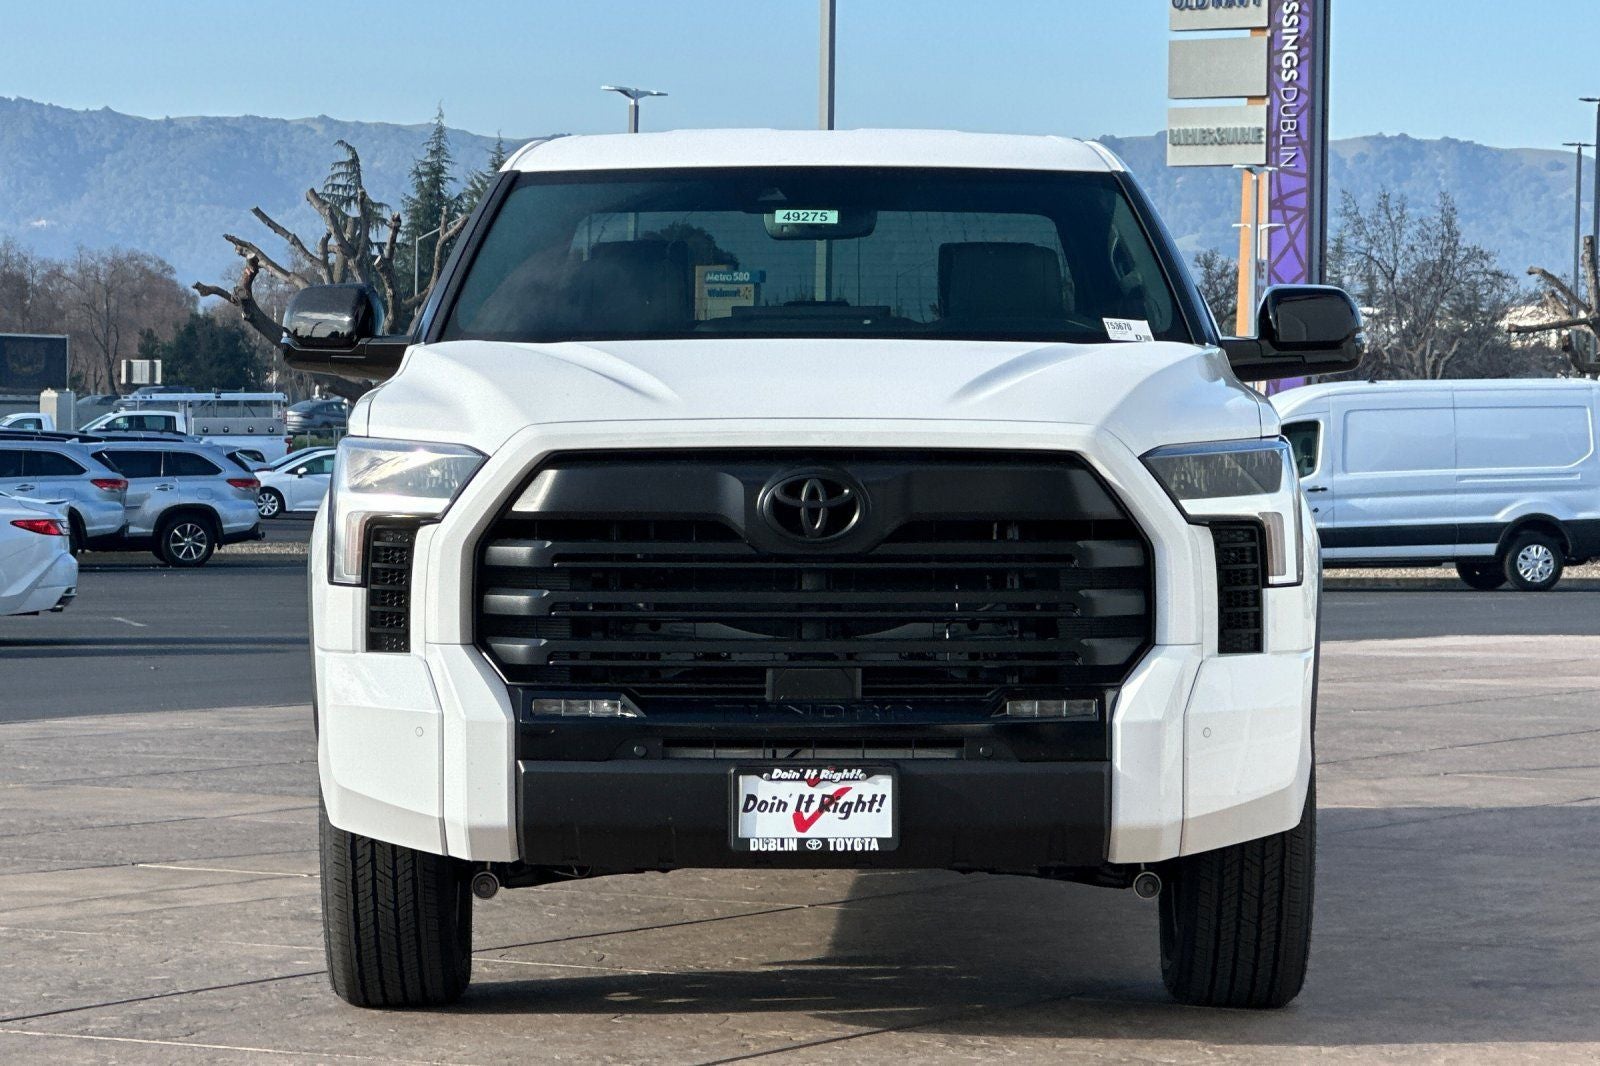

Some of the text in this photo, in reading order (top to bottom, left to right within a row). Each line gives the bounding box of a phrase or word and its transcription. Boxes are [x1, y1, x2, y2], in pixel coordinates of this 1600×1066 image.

[1280, 87, 1298, 168] DUBLIN
[783, 211, 828, 222] 49275
[705, 271, 751, 282] Metro 580
[771, 767, 862, 783] Doin' It Right!
[742, 793, 886, 820] Doin' It Right!
[750, 838, 880, 852] DUBLIN TOYOTA
